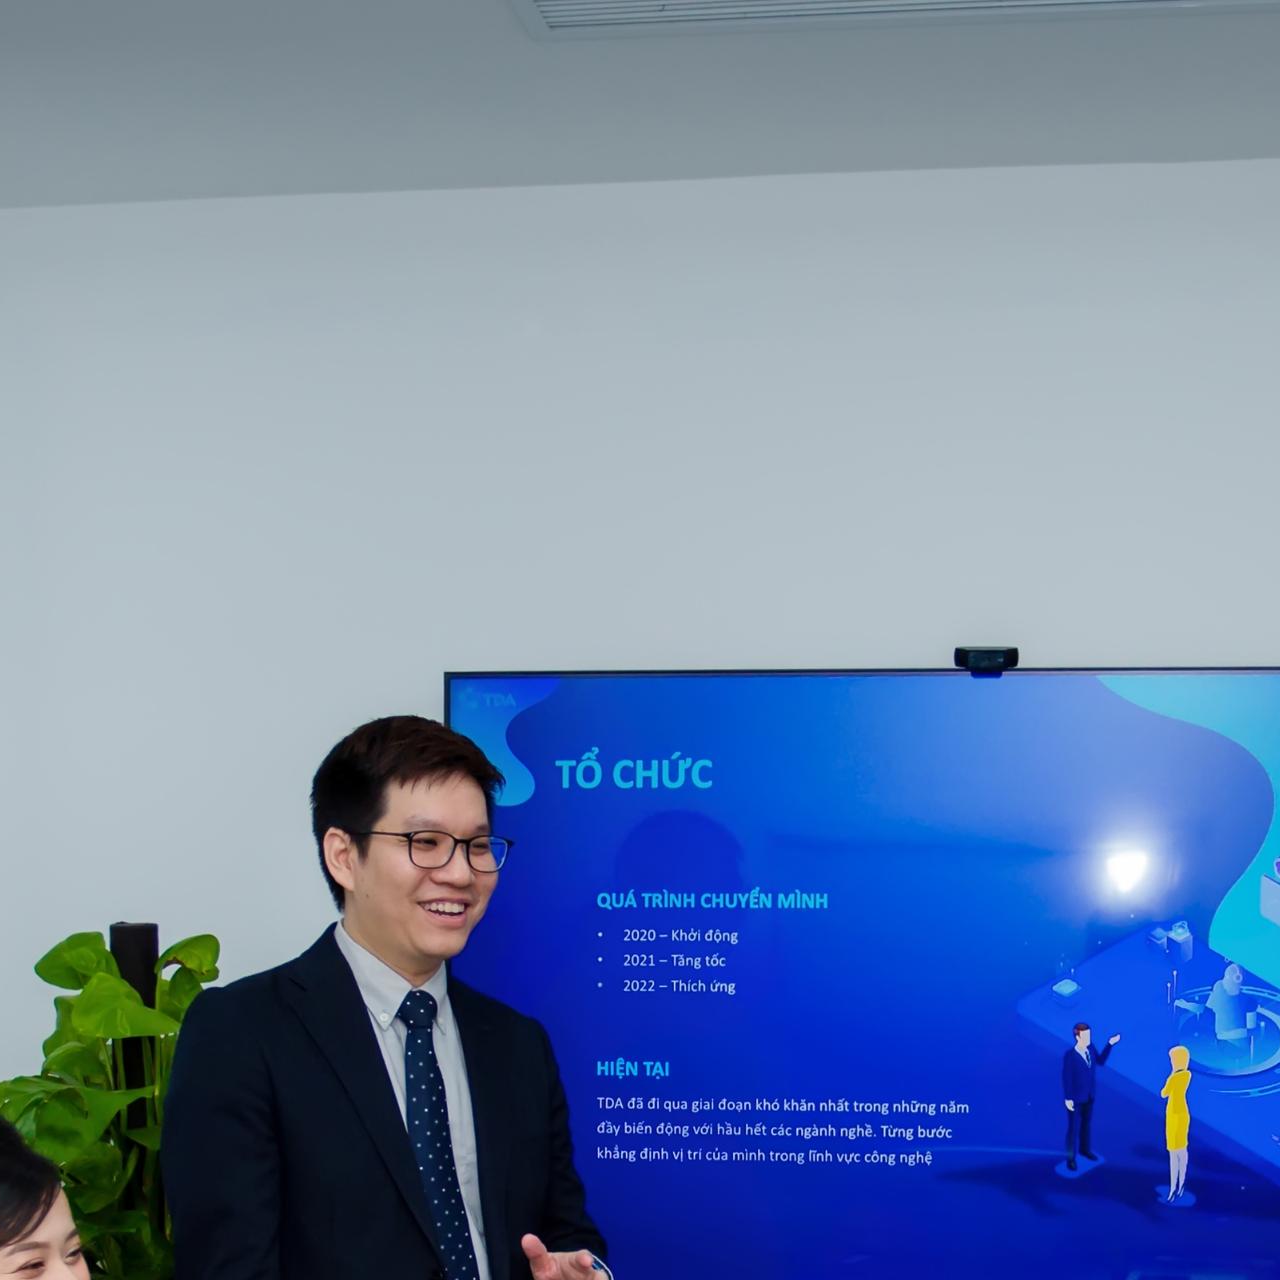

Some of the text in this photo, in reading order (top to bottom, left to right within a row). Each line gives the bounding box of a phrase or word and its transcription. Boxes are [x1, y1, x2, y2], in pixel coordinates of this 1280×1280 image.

[555, 747, 712, 789] TỔ CHỨC
[597, 886, 828, 910] QUÁ TRÌNH CHUYỂN MÌNH
[624, 929, 656, 941] 2020
[672, 928, 700, 941] Khởi
[705, 929, 738, 944] động
[624, 954, 655, 966] 2021
[671, 954, 701, 969] Tăng
[705, 953, 726, 966] tốc
[624, 980, 655, 991] 2022
[671, 980, 705, 992] Thích
[711, 980, 735, 995] ứng
[597, 1057, 669, 1079] HIỆN TẠI
[597, 1097, 969, 1115] TDA đã đi qua giai đoạn khó khăn nhất trong những năm
[597, 1121, 952, 1140] đầy biến động với hầu hết các ngành nghề. Từng bước
[598, 1145, 932, 1166] khẳng định vị trí của mình trong lĩnh vực công nghệ
